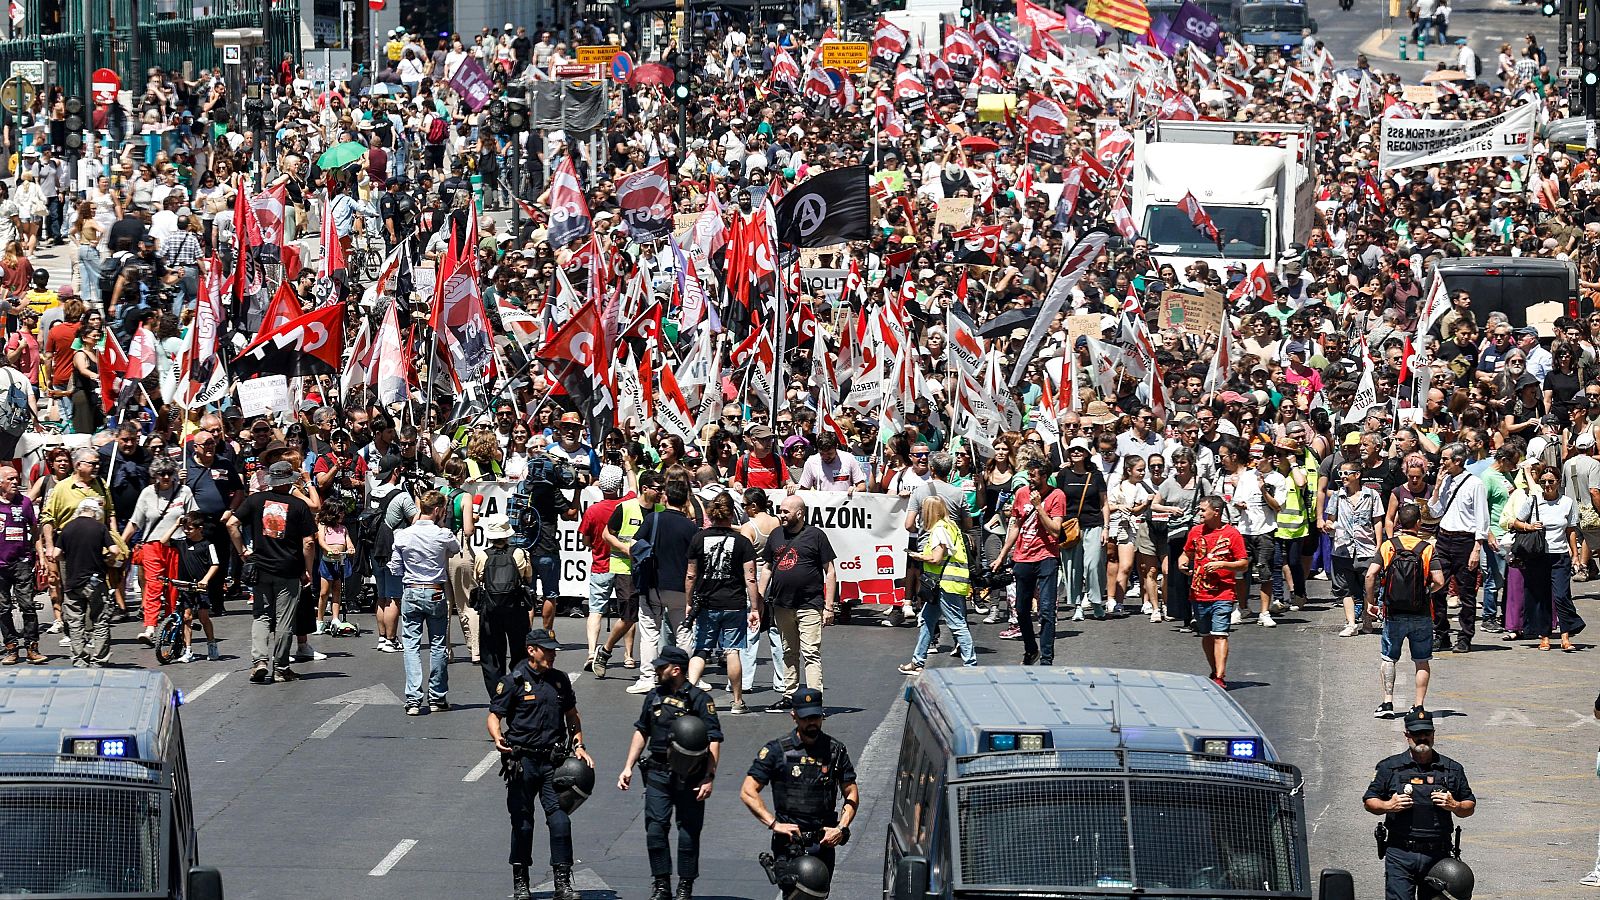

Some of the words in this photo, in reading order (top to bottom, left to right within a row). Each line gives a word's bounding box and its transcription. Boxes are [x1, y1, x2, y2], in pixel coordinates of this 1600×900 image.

[877, 47, 900, 63] CGT
[948, 53, 971, 65] CGT
[936, 78, 954, 89] CG
[807, 88, 827, 105] CGT
[1032, 129, 1063, 148] CGT
[1387, 127, 1404, 138] 228
[949, 341, 981, 369] SINDICAL
